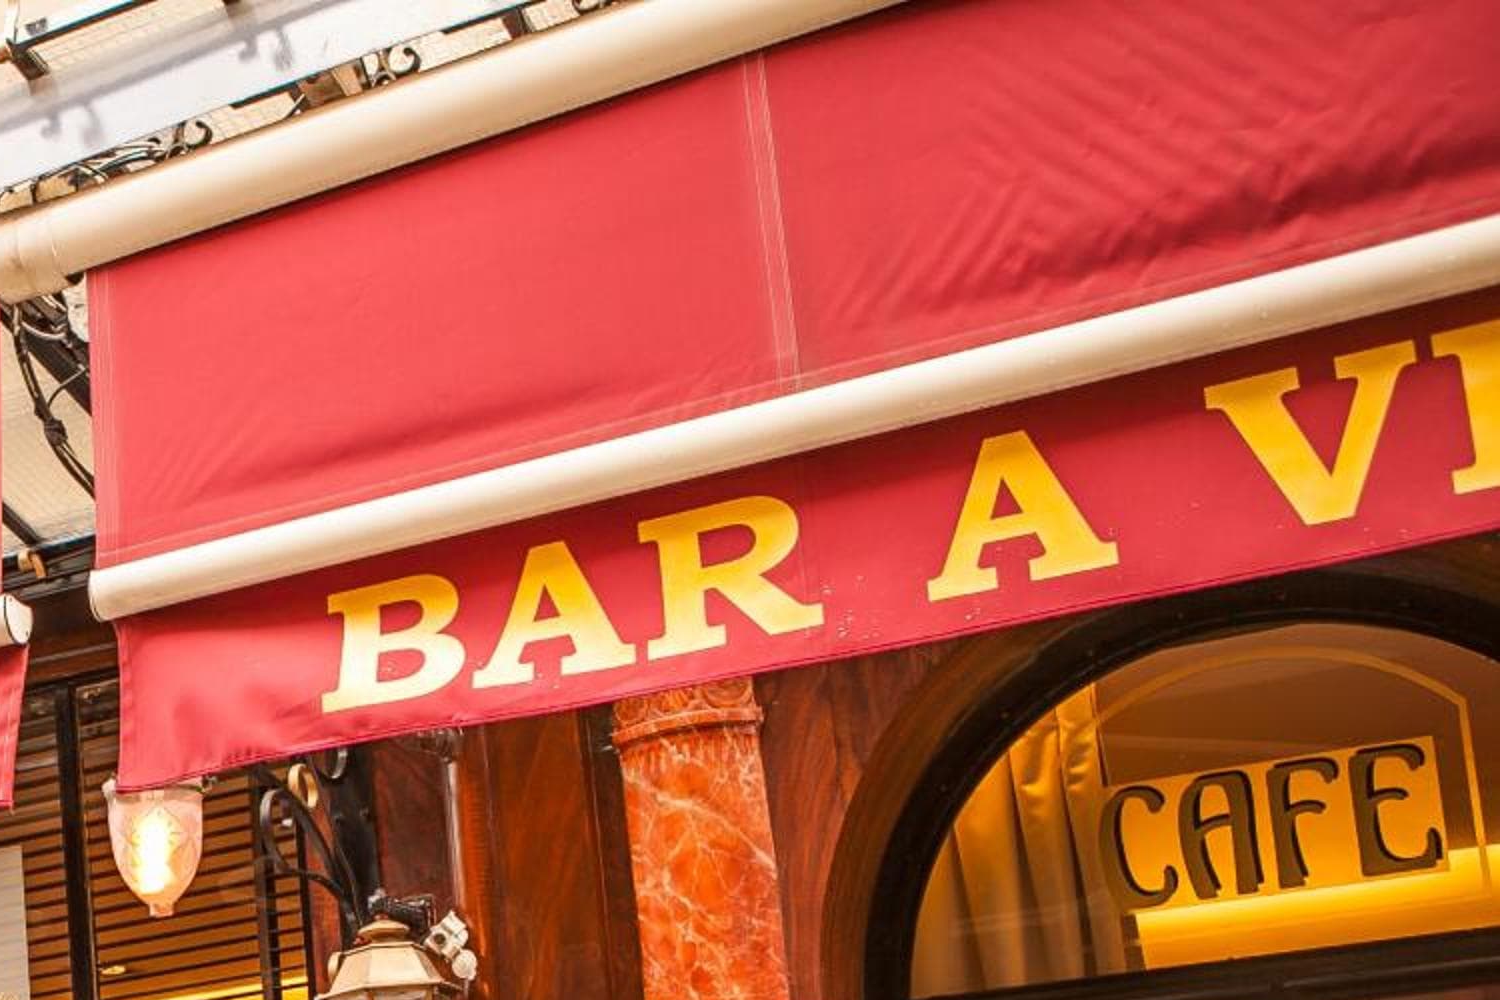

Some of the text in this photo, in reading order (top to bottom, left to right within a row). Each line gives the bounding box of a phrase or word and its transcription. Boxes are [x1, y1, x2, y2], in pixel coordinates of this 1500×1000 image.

[321, 494, 824, 714] BAR
[927, 430, 1120, 603] A
[1104, 743, 1443, 909] CAFE
